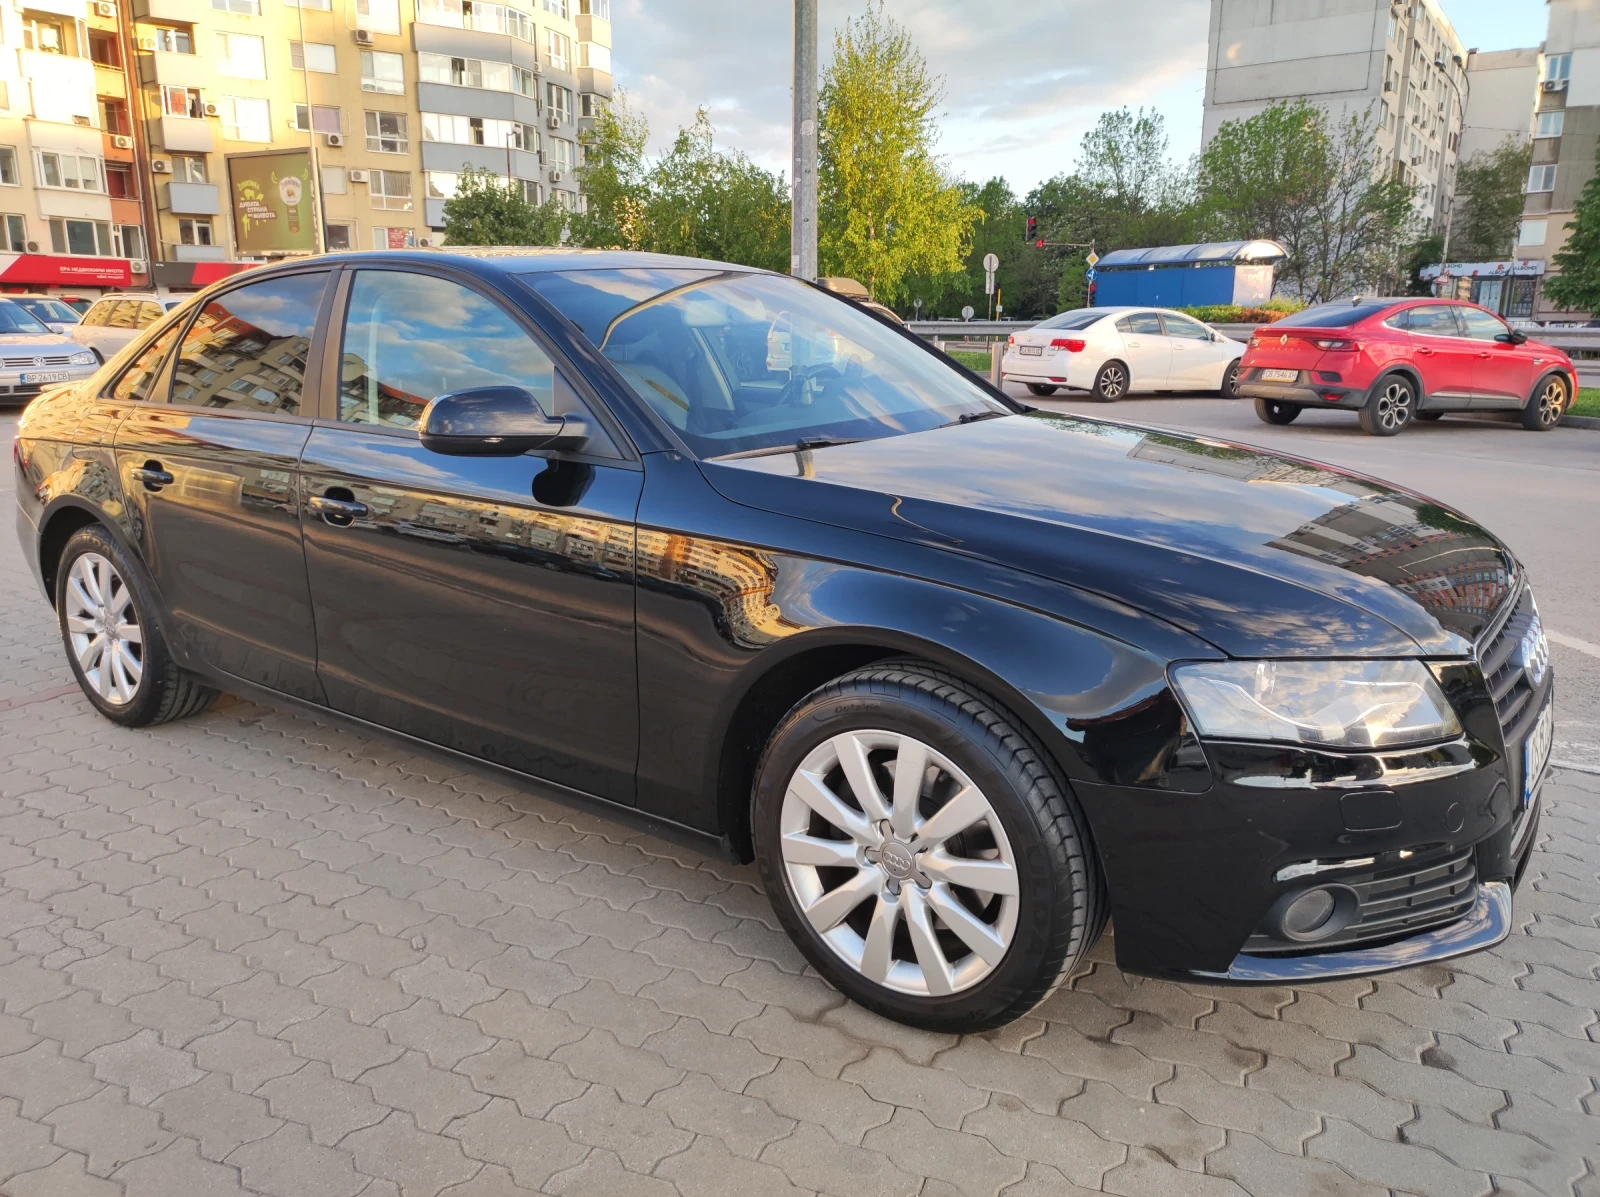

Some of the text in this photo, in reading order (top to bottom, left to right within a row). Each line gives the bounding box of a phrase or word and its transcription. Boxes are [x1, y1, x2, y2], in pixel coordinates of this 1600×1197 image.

[26, 373, 68, 382] BP 2619 CB
